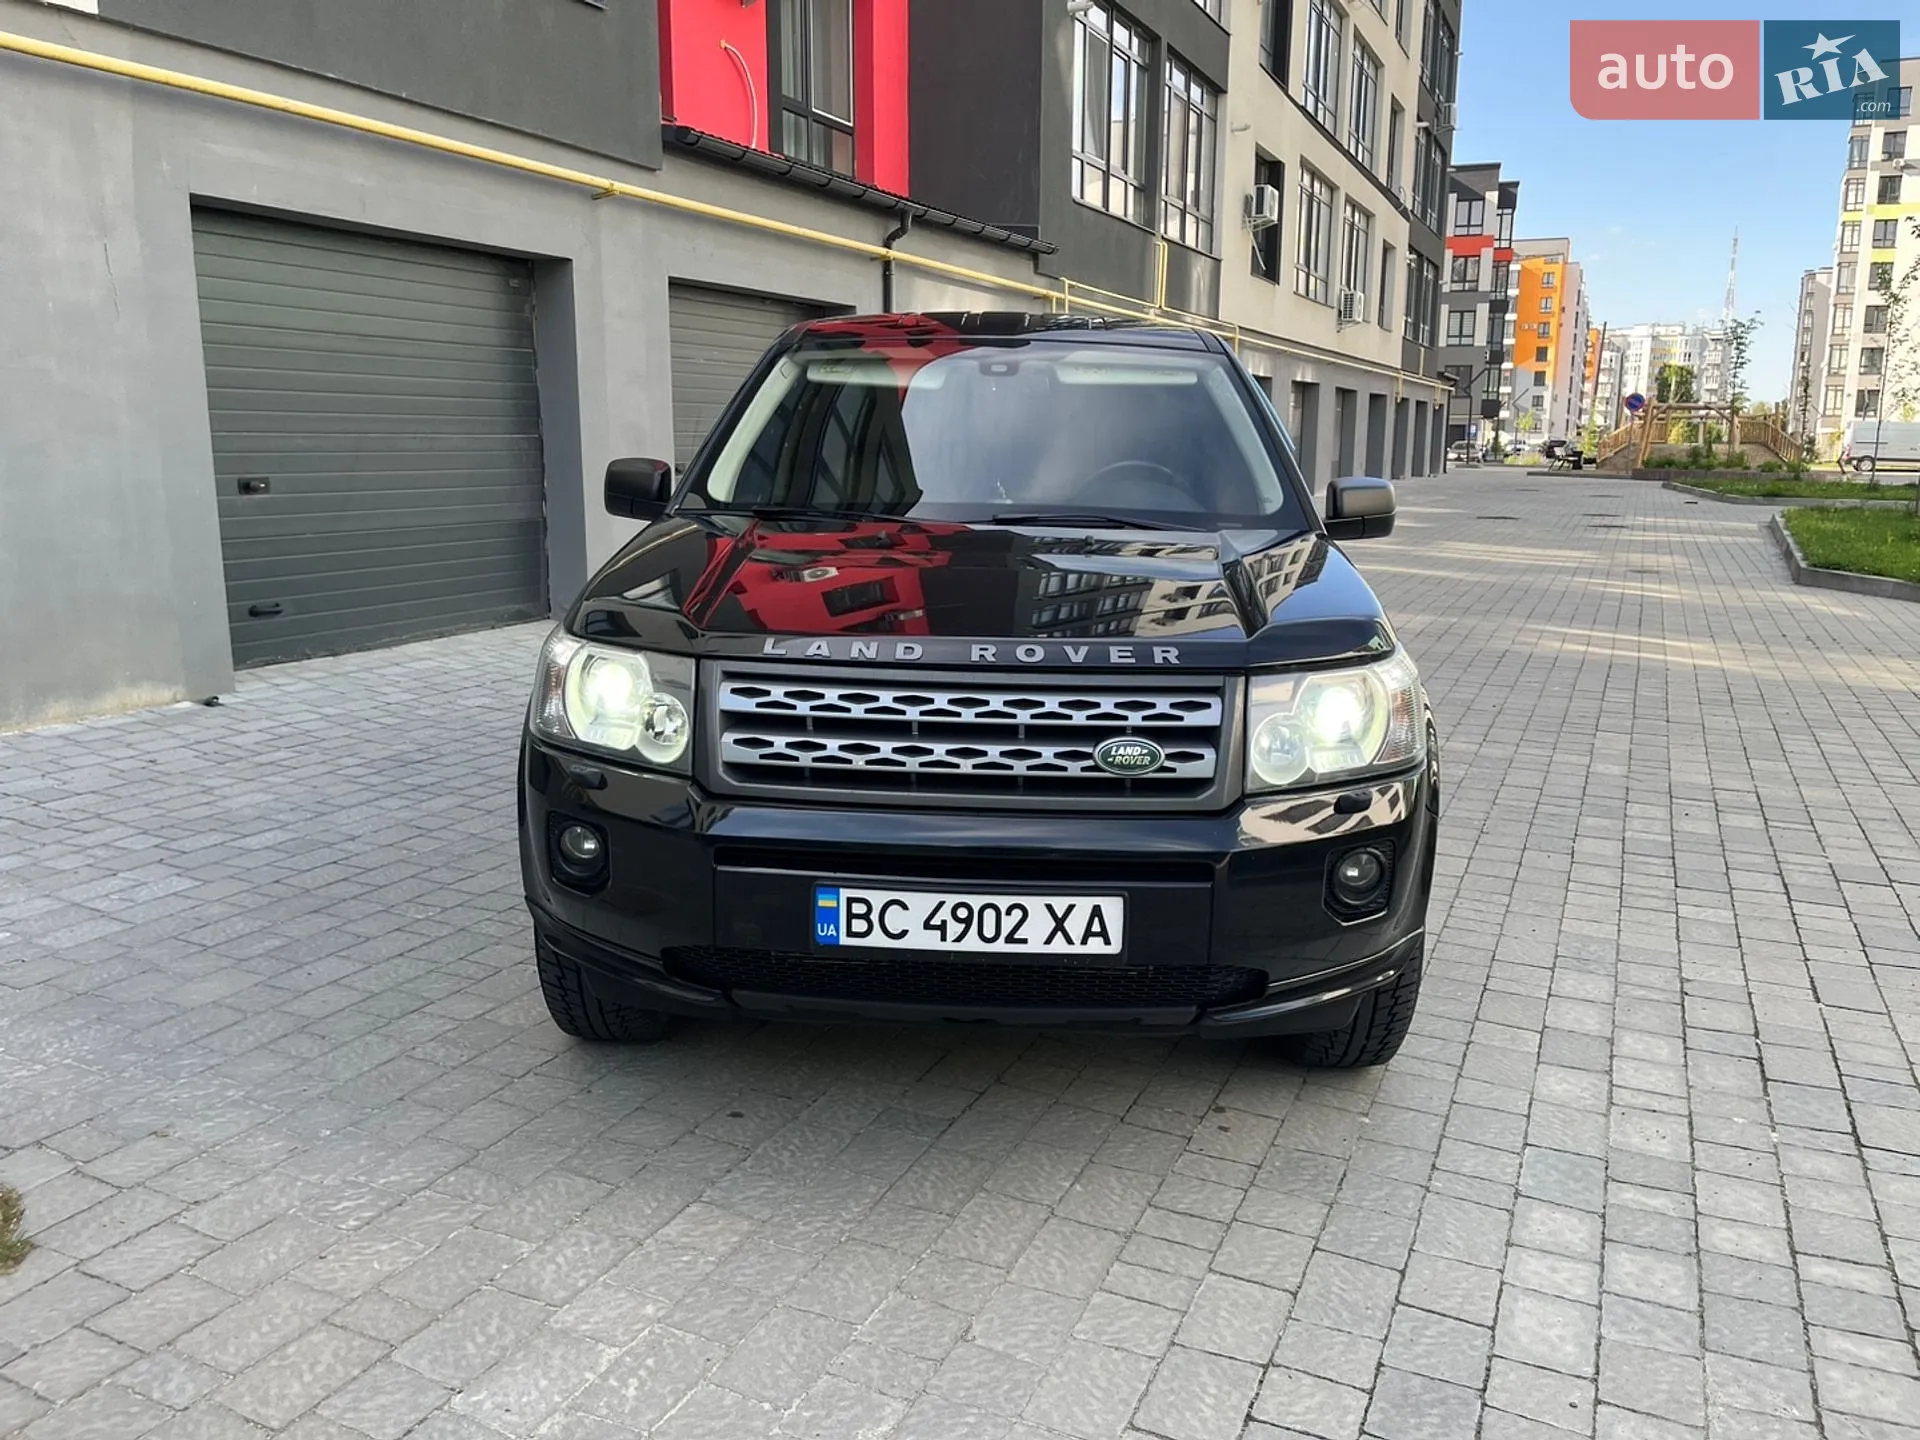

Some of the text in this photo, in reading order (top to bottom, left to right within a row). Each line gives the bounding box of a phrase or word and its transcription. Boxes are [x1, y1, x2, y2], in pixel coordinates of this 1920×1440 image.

[762, 637, 1181, 665] LAND ROVER
[817, 923, 837, 936] UA
[846, 897, 1112, 945] BC 4902 XA
